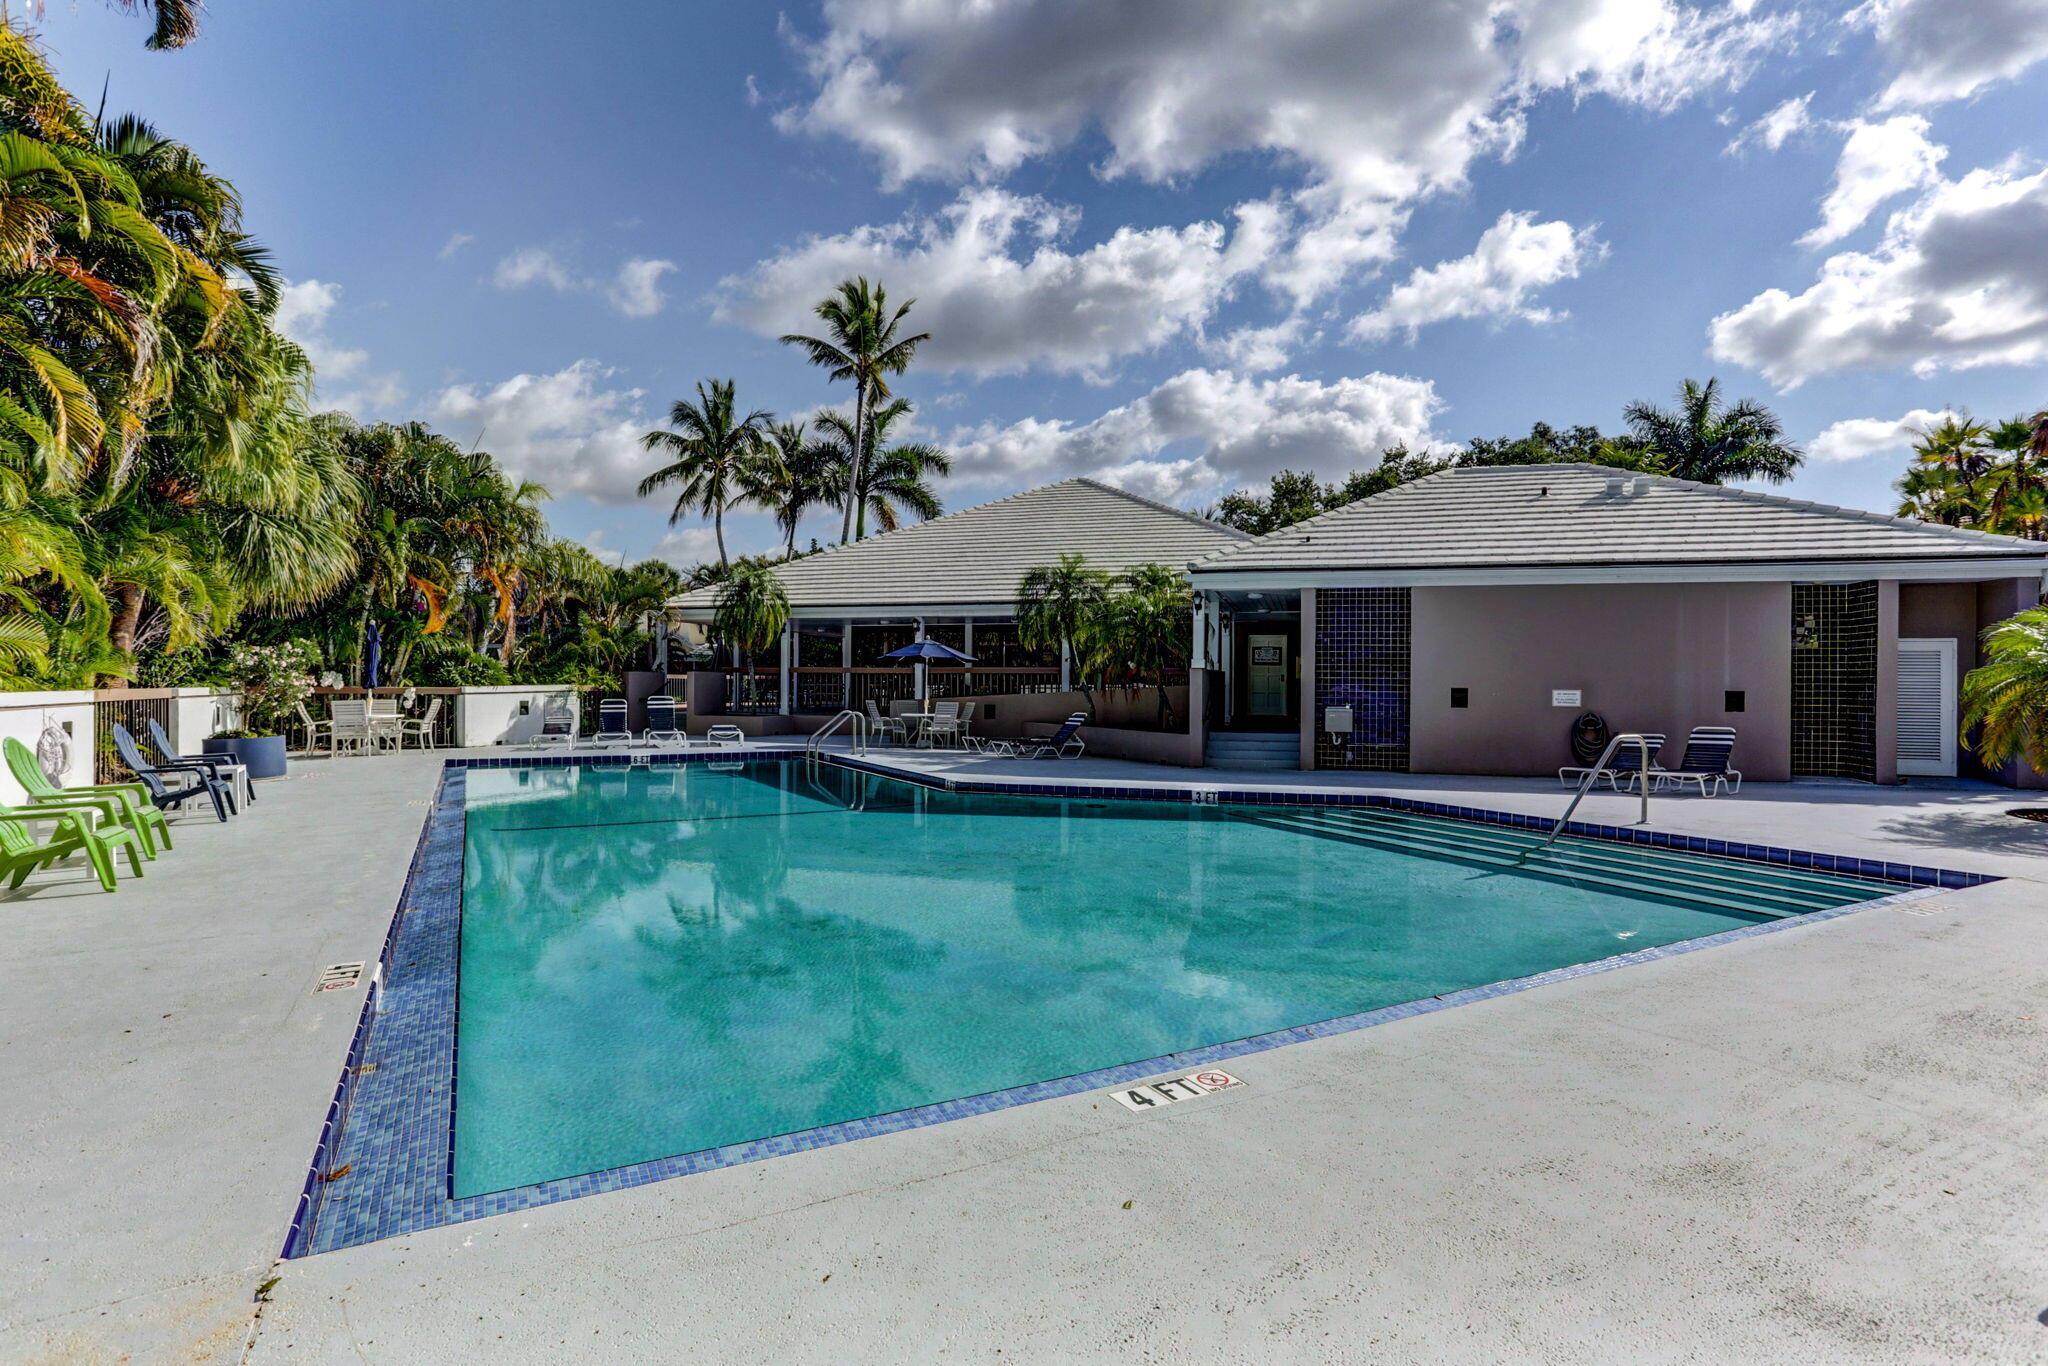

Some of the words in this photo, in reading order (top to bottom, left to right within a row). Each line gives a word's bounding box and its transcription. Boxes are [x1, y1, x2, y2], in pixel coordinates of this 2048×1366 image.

[633, 755, 638, 764] 6
[1195, 791, 1201, 804] 3
[1205, 791, 1217, 803] FT
[1127, 1090, 1156, 1107] 4
[1151, 1078, 1200, 1101] FT
